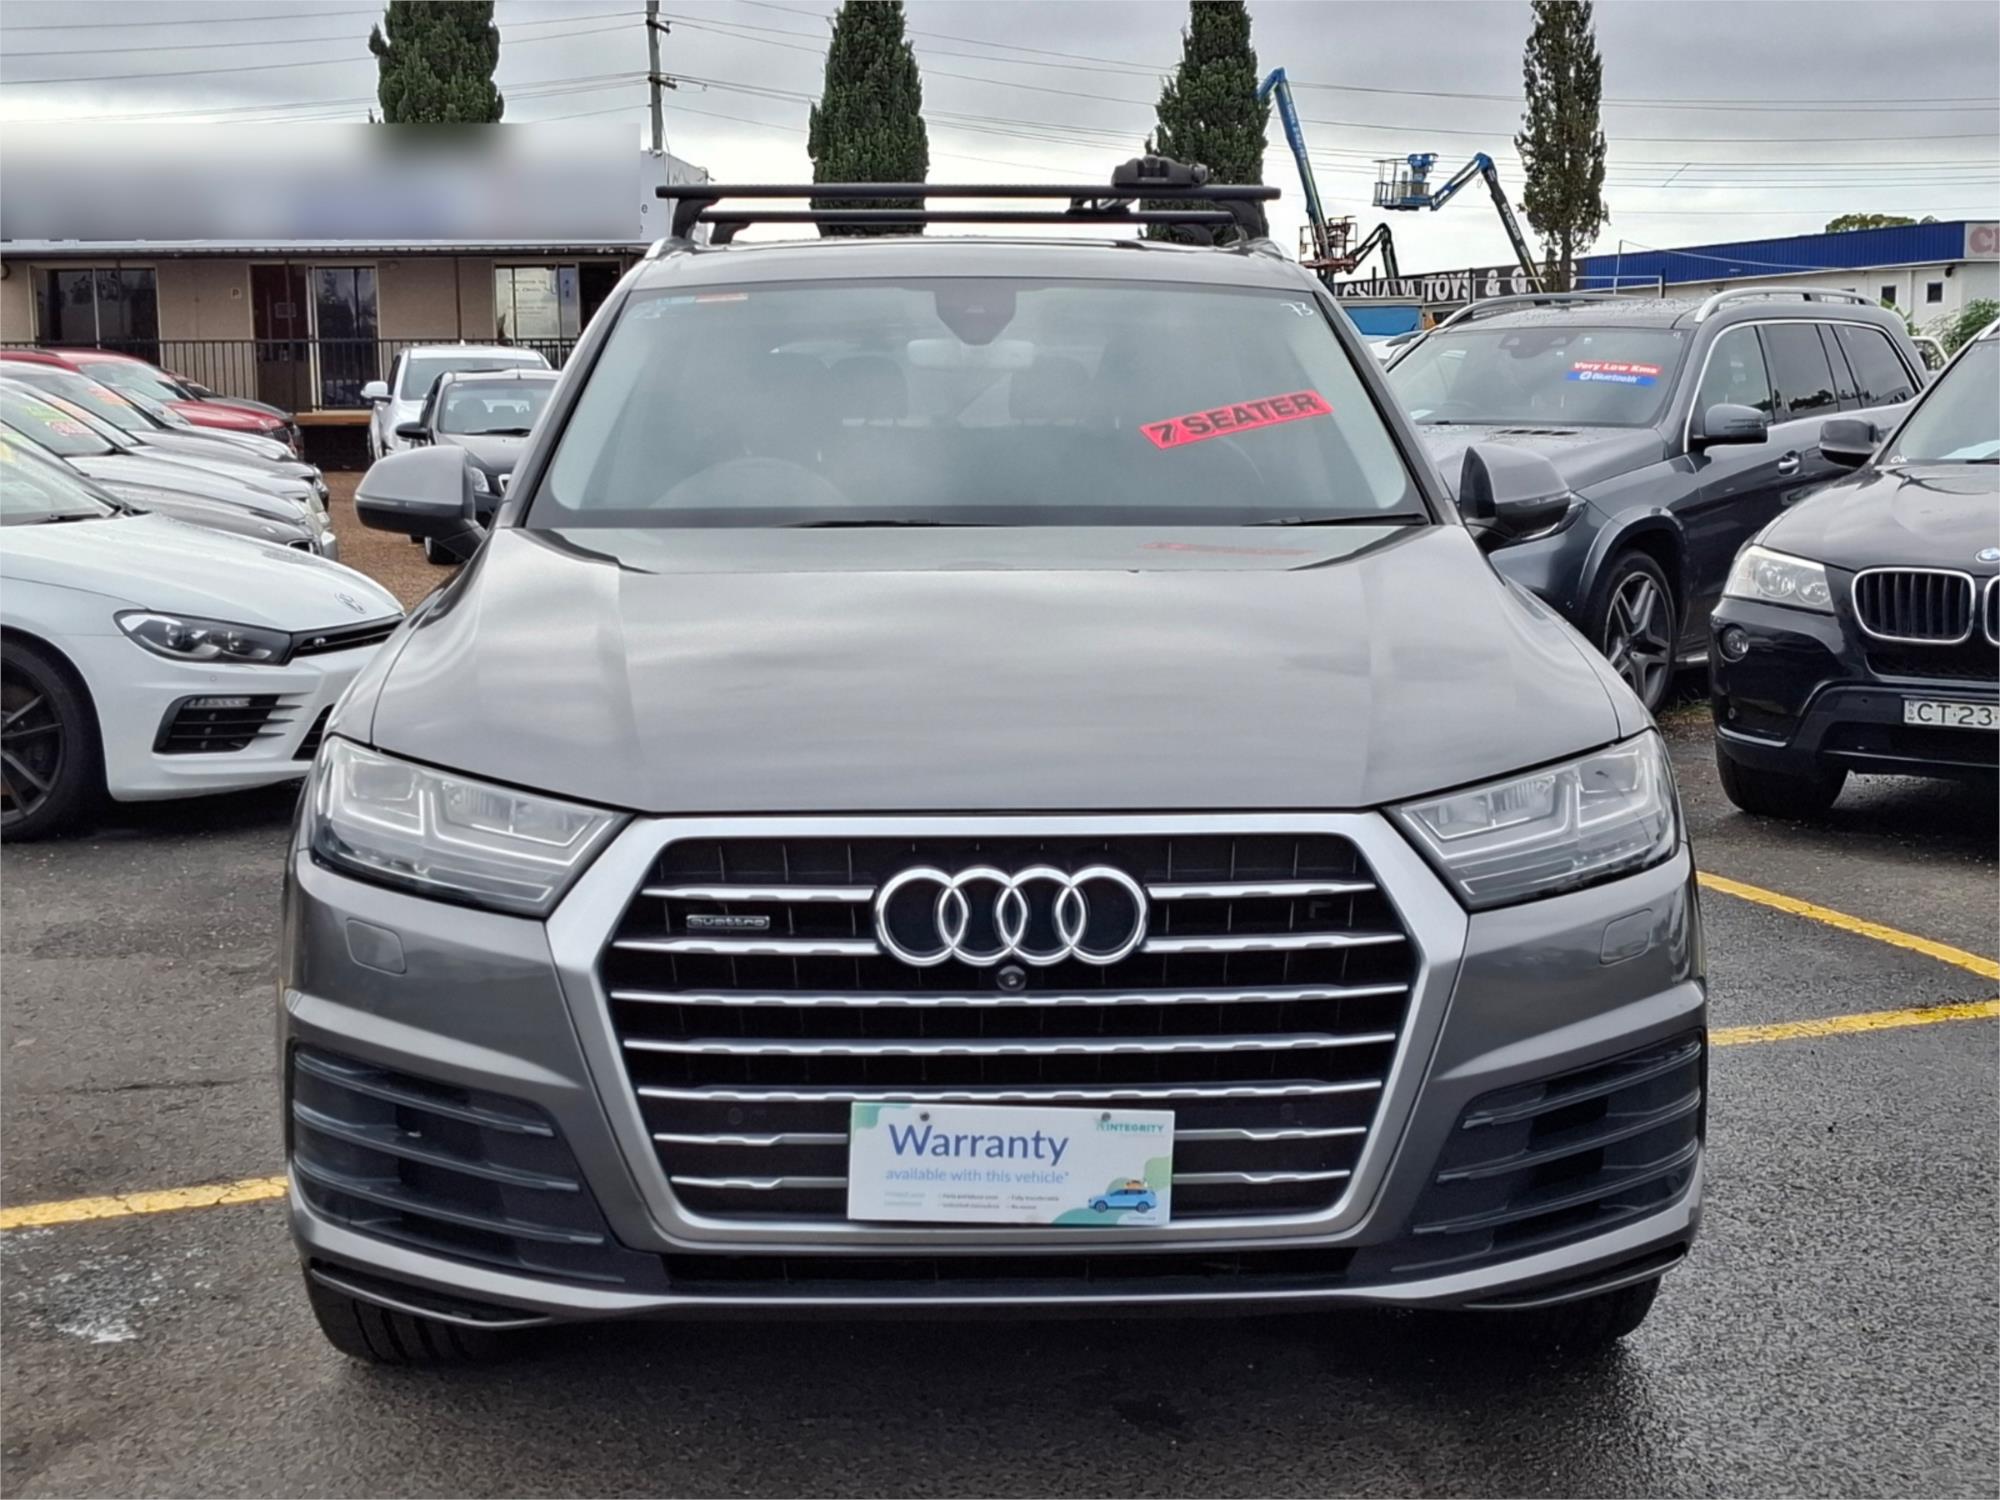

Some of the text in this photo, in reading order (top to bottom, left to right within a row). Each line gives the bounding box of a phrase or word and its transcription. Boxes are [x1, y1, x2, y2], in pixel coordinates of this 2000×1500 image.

[1150, 392, 1320, 444] 7 SEATER
[1106, 1123, 1164, 1133] INTEGRITY
[888, 1123, 1070, 1167] Warranty
[885, 1167, 946, 1182] available
[951, 1169, 982, 1183] with
[986, 1169, 1011, 1183] this
